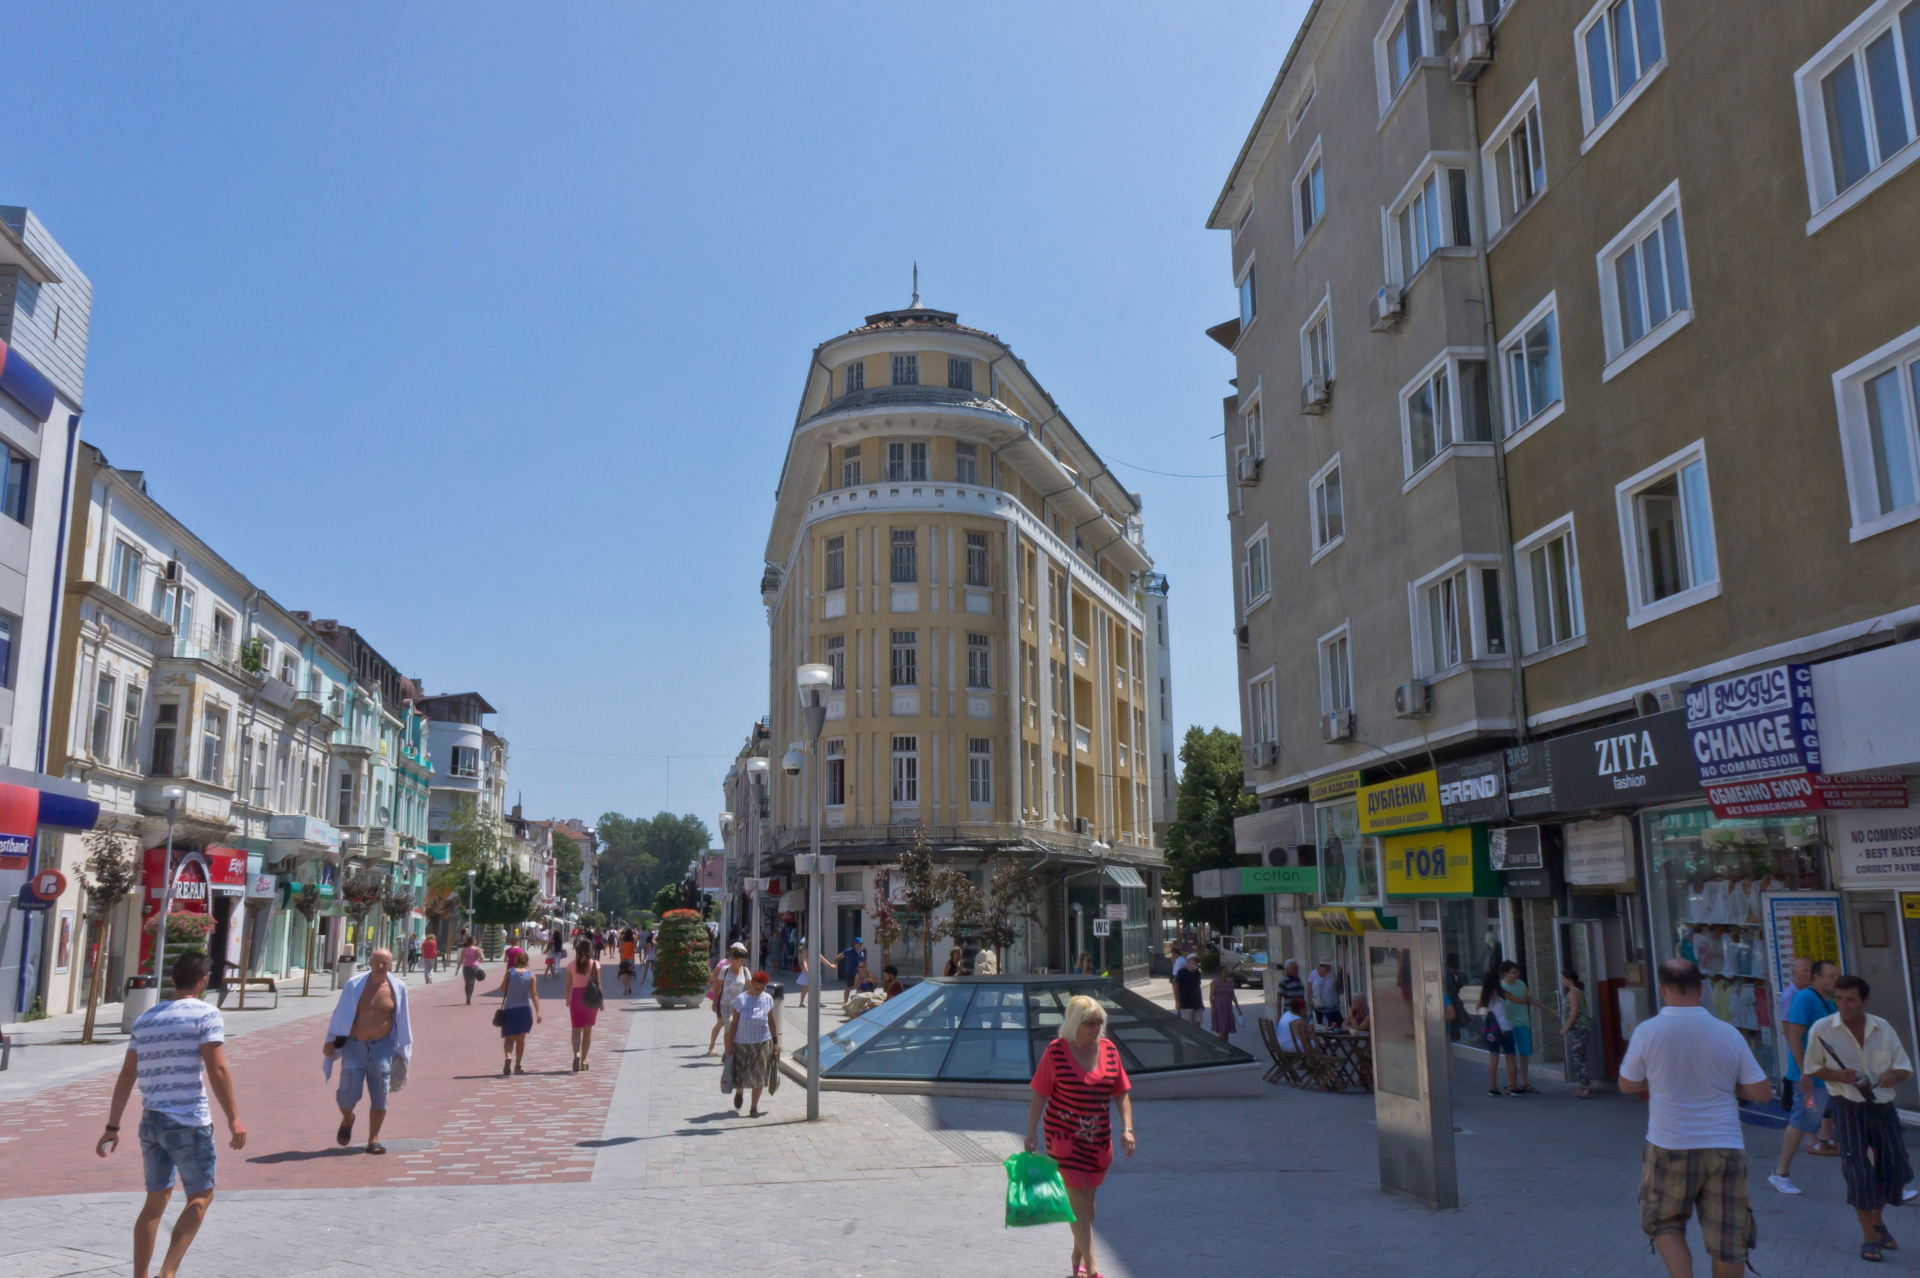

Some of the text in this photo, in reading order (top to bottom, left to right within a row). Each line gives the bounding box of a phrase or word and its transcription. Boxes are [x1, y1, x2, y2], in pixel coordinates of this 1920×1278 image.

[1796, 669, 1820, 764] CHANGE
[1693, 714, 1796, 763] CHANGE
[1594, 730, 1658, 776] ZITA
[1700, 765, 1717, 778] NO
[1719, 752, 1800, 774] COMMISSION
[1328, 779, 1359, 795] ИЗДЕЛИЯ
[1613, 773, 1646, 790] fashion
[1815, 774, 1904, 784] NO COMMISSION
[1367, 781, 1426, 816] ДУБЛЁНКИ
[1439, 774, 1499, 806] BRAND
[1709, 778, 1813, 806] ОБМЕННО БЮРО
[1725, 800, 1807, 815] БЕЗ КОМИСИОННА
[1851, 830, 1865, 843] NO
[0, 838, 29, 854] ostbank
[1865, 848, 1888, 859] BEST
[1405, 845, 1447, 880] ГОЯ
[1856, 863, 1920, 874] CORRECT PAYM
[1253, 869, 1300, 882] cotton
[177, 881, 206, 899] REFAN
[1095, 921, 1108, 933] WC
